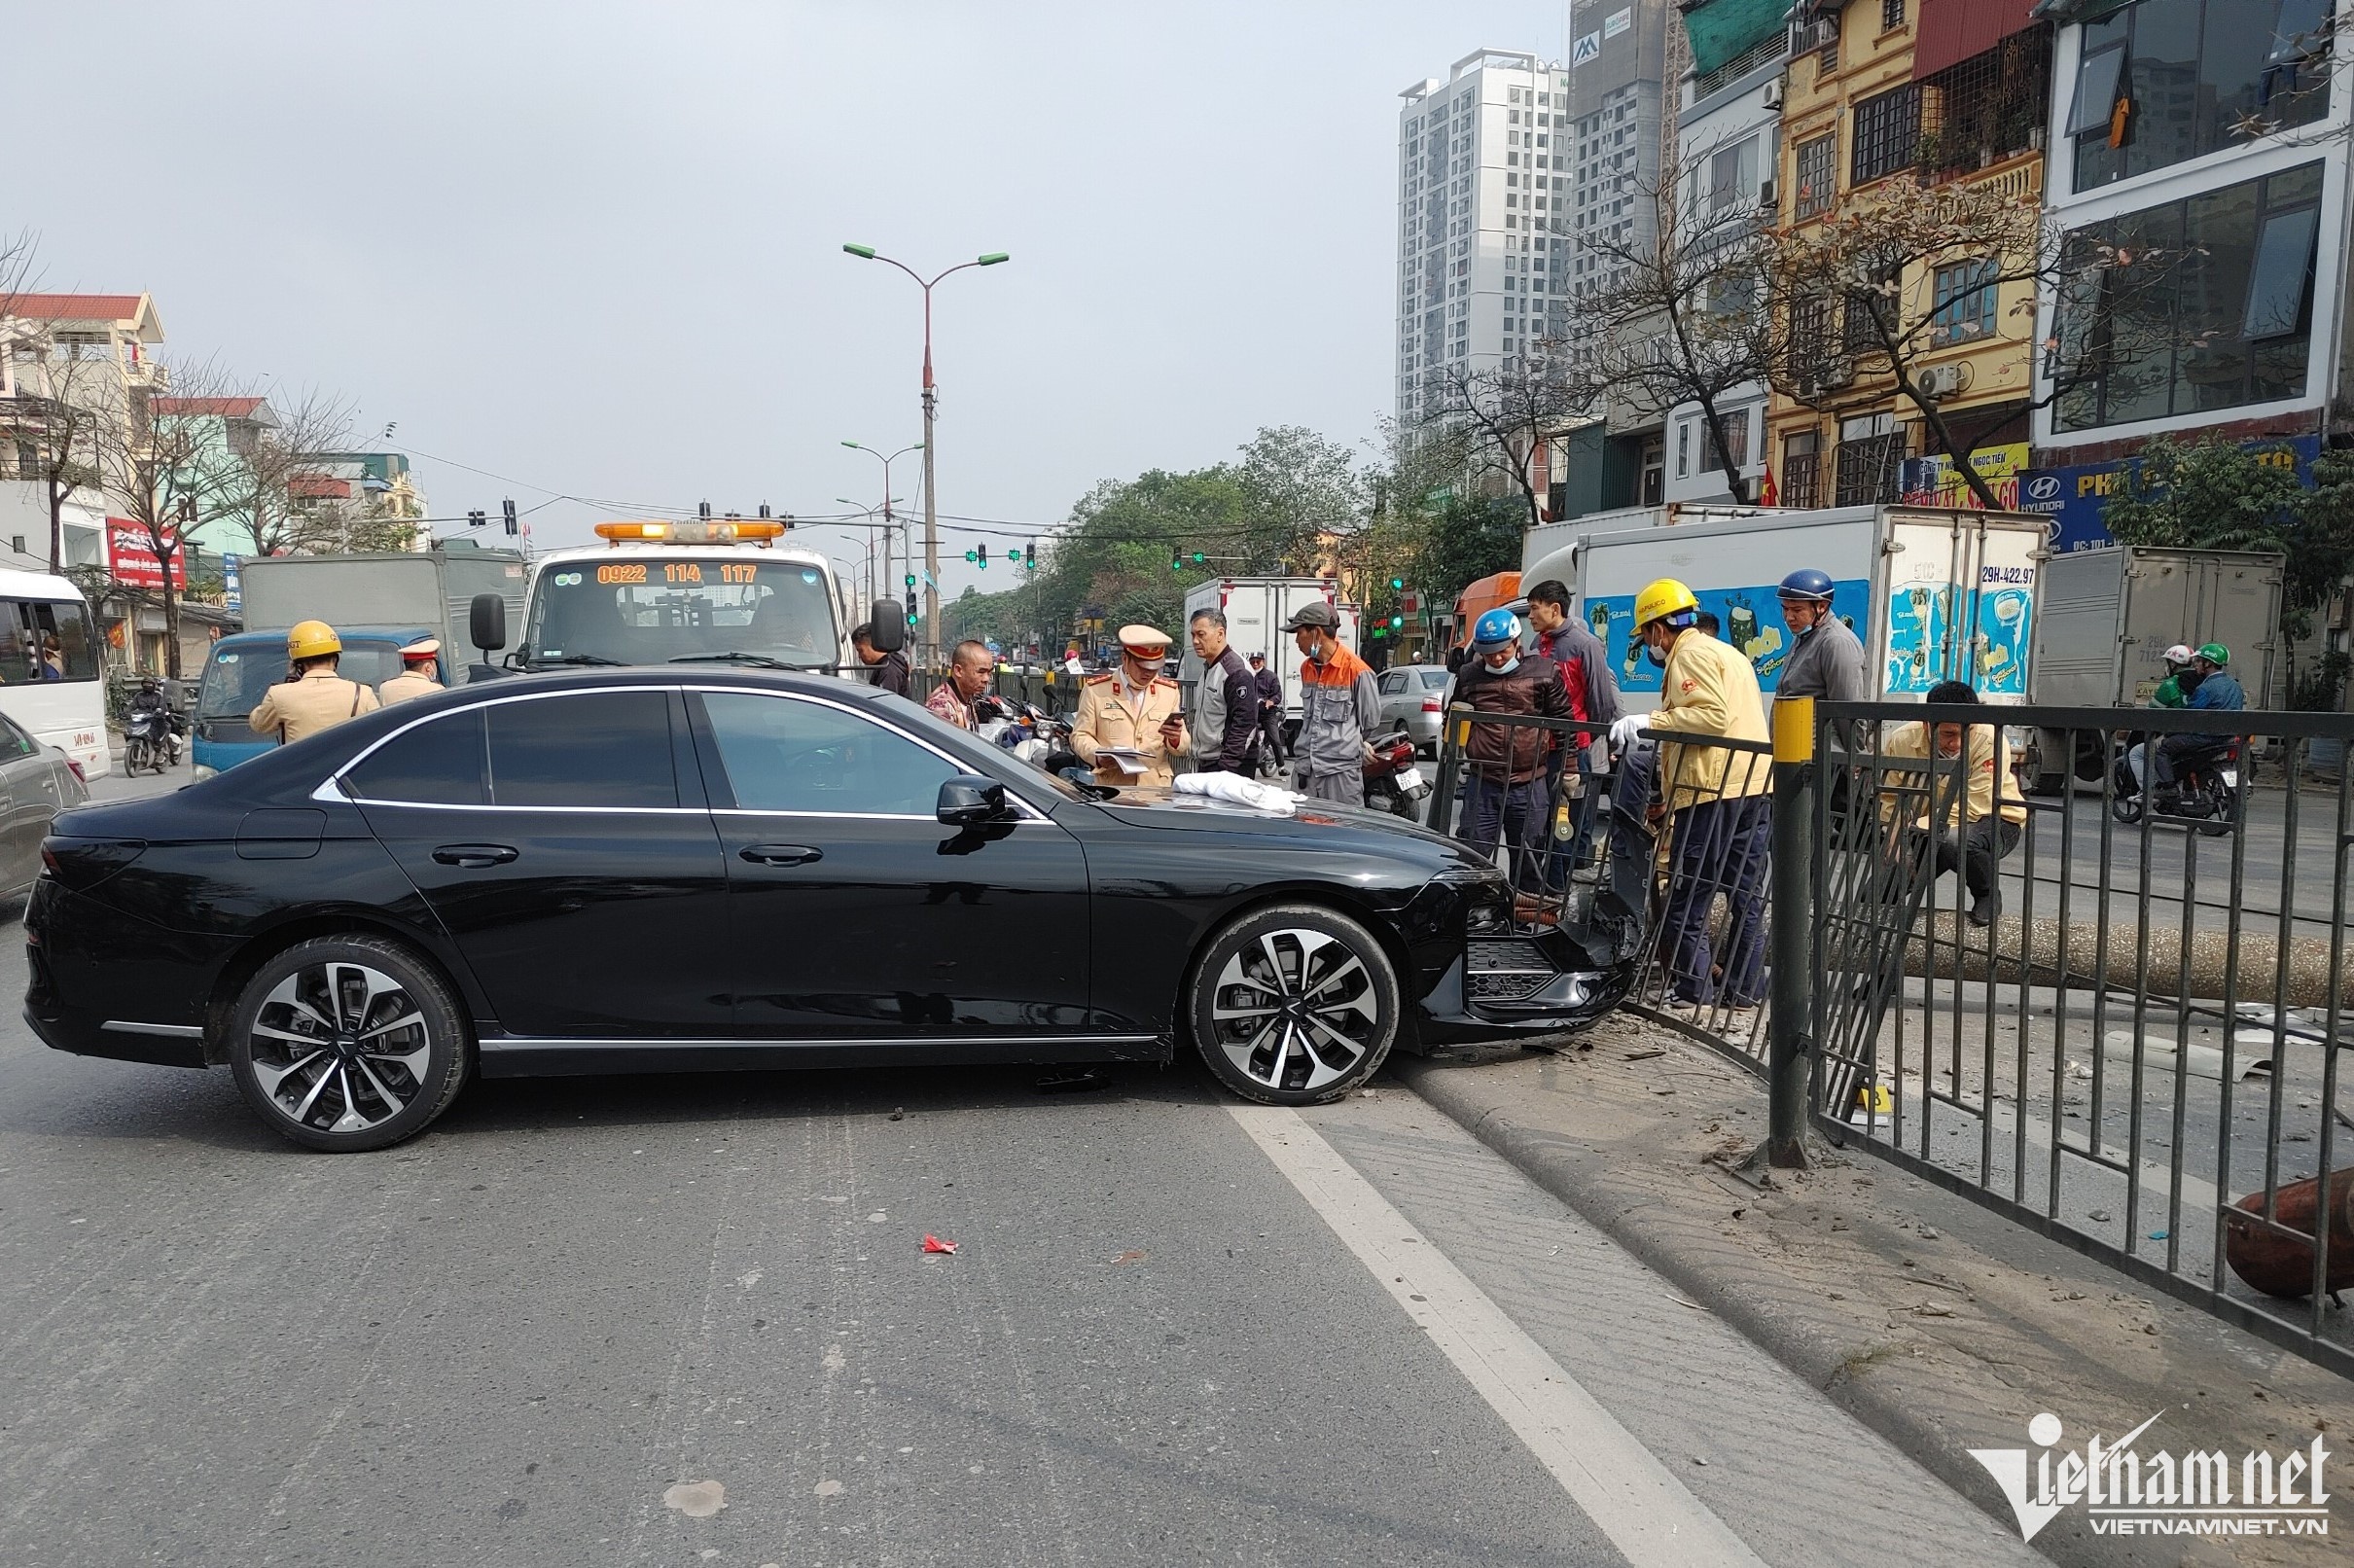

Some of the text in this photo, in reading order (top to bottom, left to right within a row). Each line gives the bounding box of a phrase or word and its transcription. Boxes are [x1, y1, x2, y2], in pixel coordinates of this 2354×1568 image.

[2021, 500, 2065, 513] HYUNDAI
[2090, 539, 2105, 550] 101
[597, 564, 757, 584] 0922 114 117
[1982, 566, 2034, 585] 29H-422.97
[2204, 650, 2218, 659] Grab
